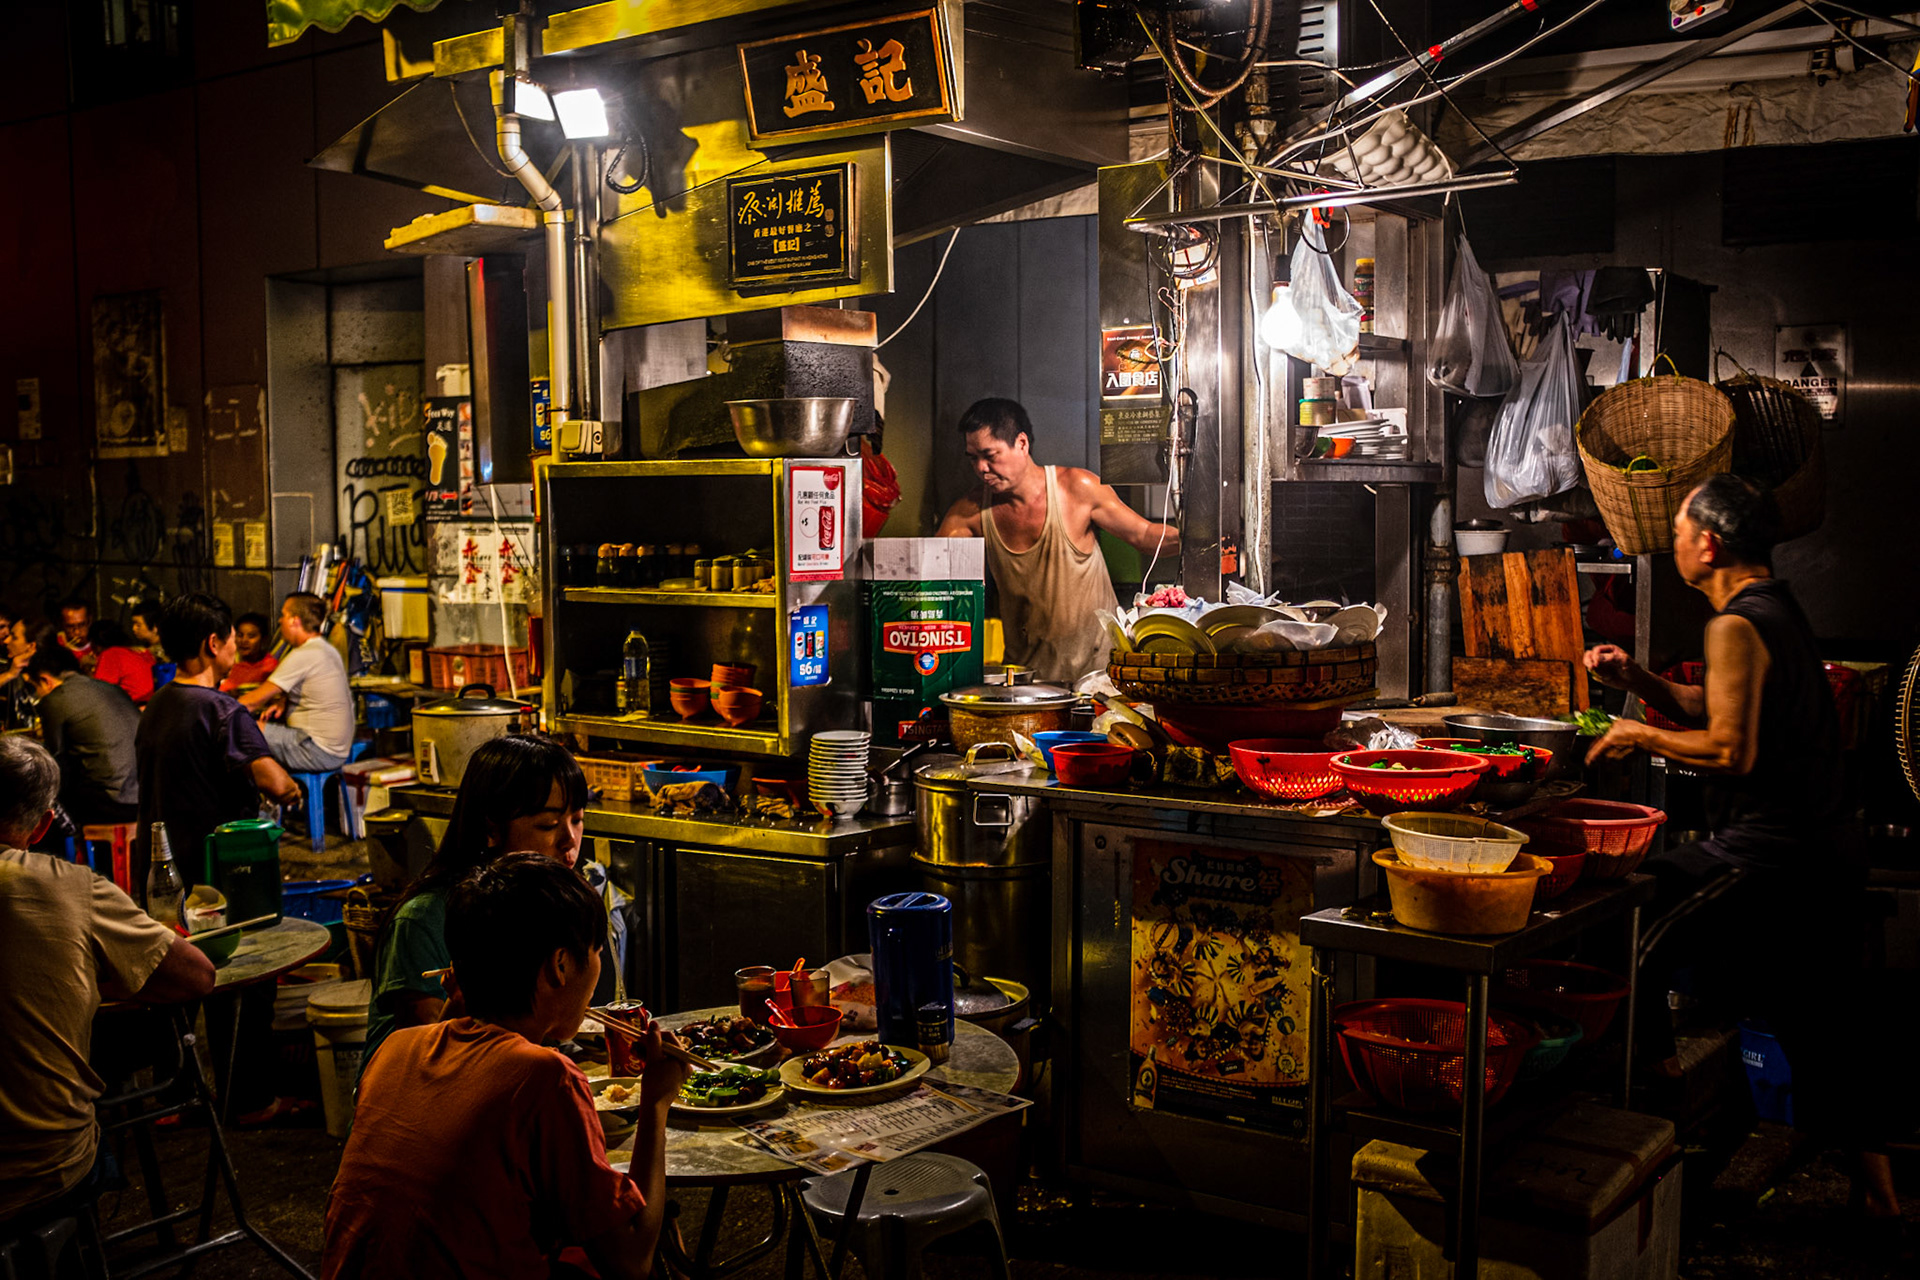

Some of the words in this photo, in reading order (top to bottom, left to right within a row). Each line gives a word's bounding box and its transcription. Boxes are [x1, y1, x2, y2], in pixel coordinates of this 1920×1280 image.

[782, 37, 914, 119] 盛記
[889, 629, 966, 647] TSINGTAO
[1161, 857, 1257, 893] Share
